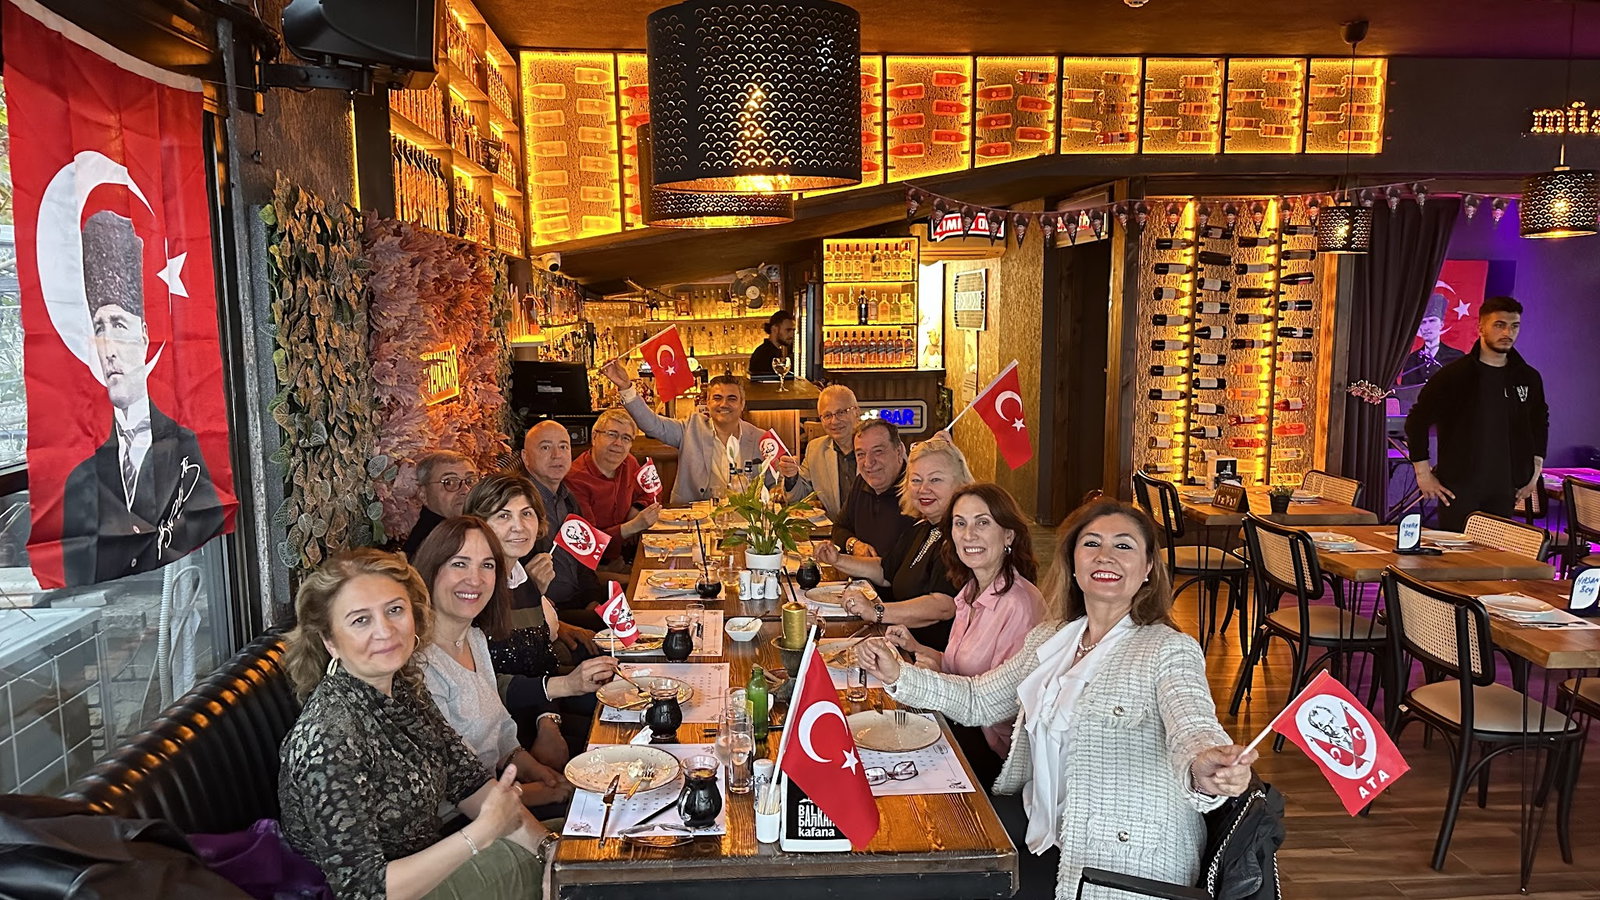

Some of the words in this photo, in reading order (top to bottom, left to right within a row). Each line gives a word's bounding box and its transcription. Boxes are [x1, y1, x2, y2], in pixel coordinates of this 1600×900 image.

[880, 408, 914, 425] BAR
[592, 543, 606, 560] ATA
[1358, 769, 1391, 800] ATA
[798, 827, 836, 837] kafana
